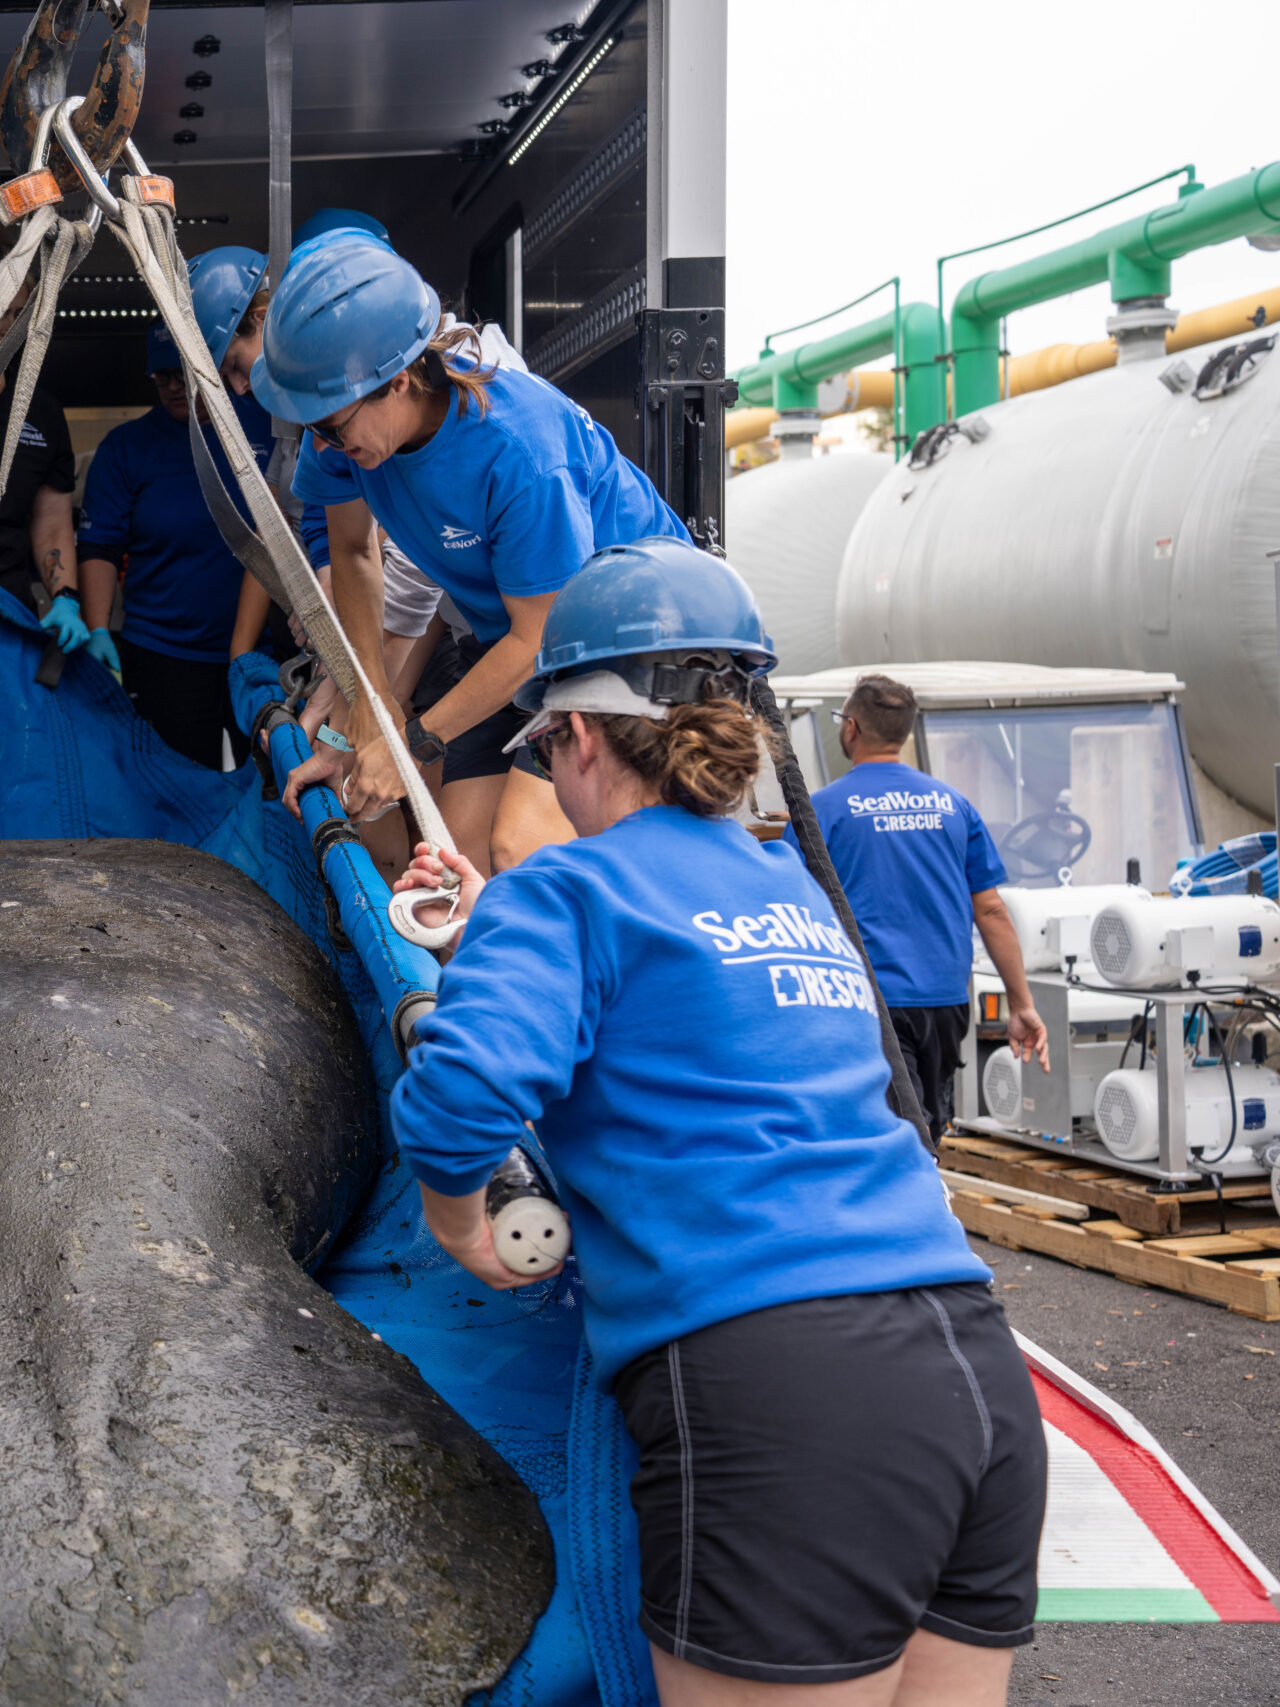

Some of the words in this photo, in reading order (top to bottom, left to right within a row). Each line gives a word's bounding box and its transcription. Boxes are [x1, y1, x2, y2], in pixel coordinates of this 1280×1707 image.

[888, 814, 944, 832] RESCUE
[692, 903, 864, 965] SeaWorl
[798, 965, 879, 1018] RESCU
